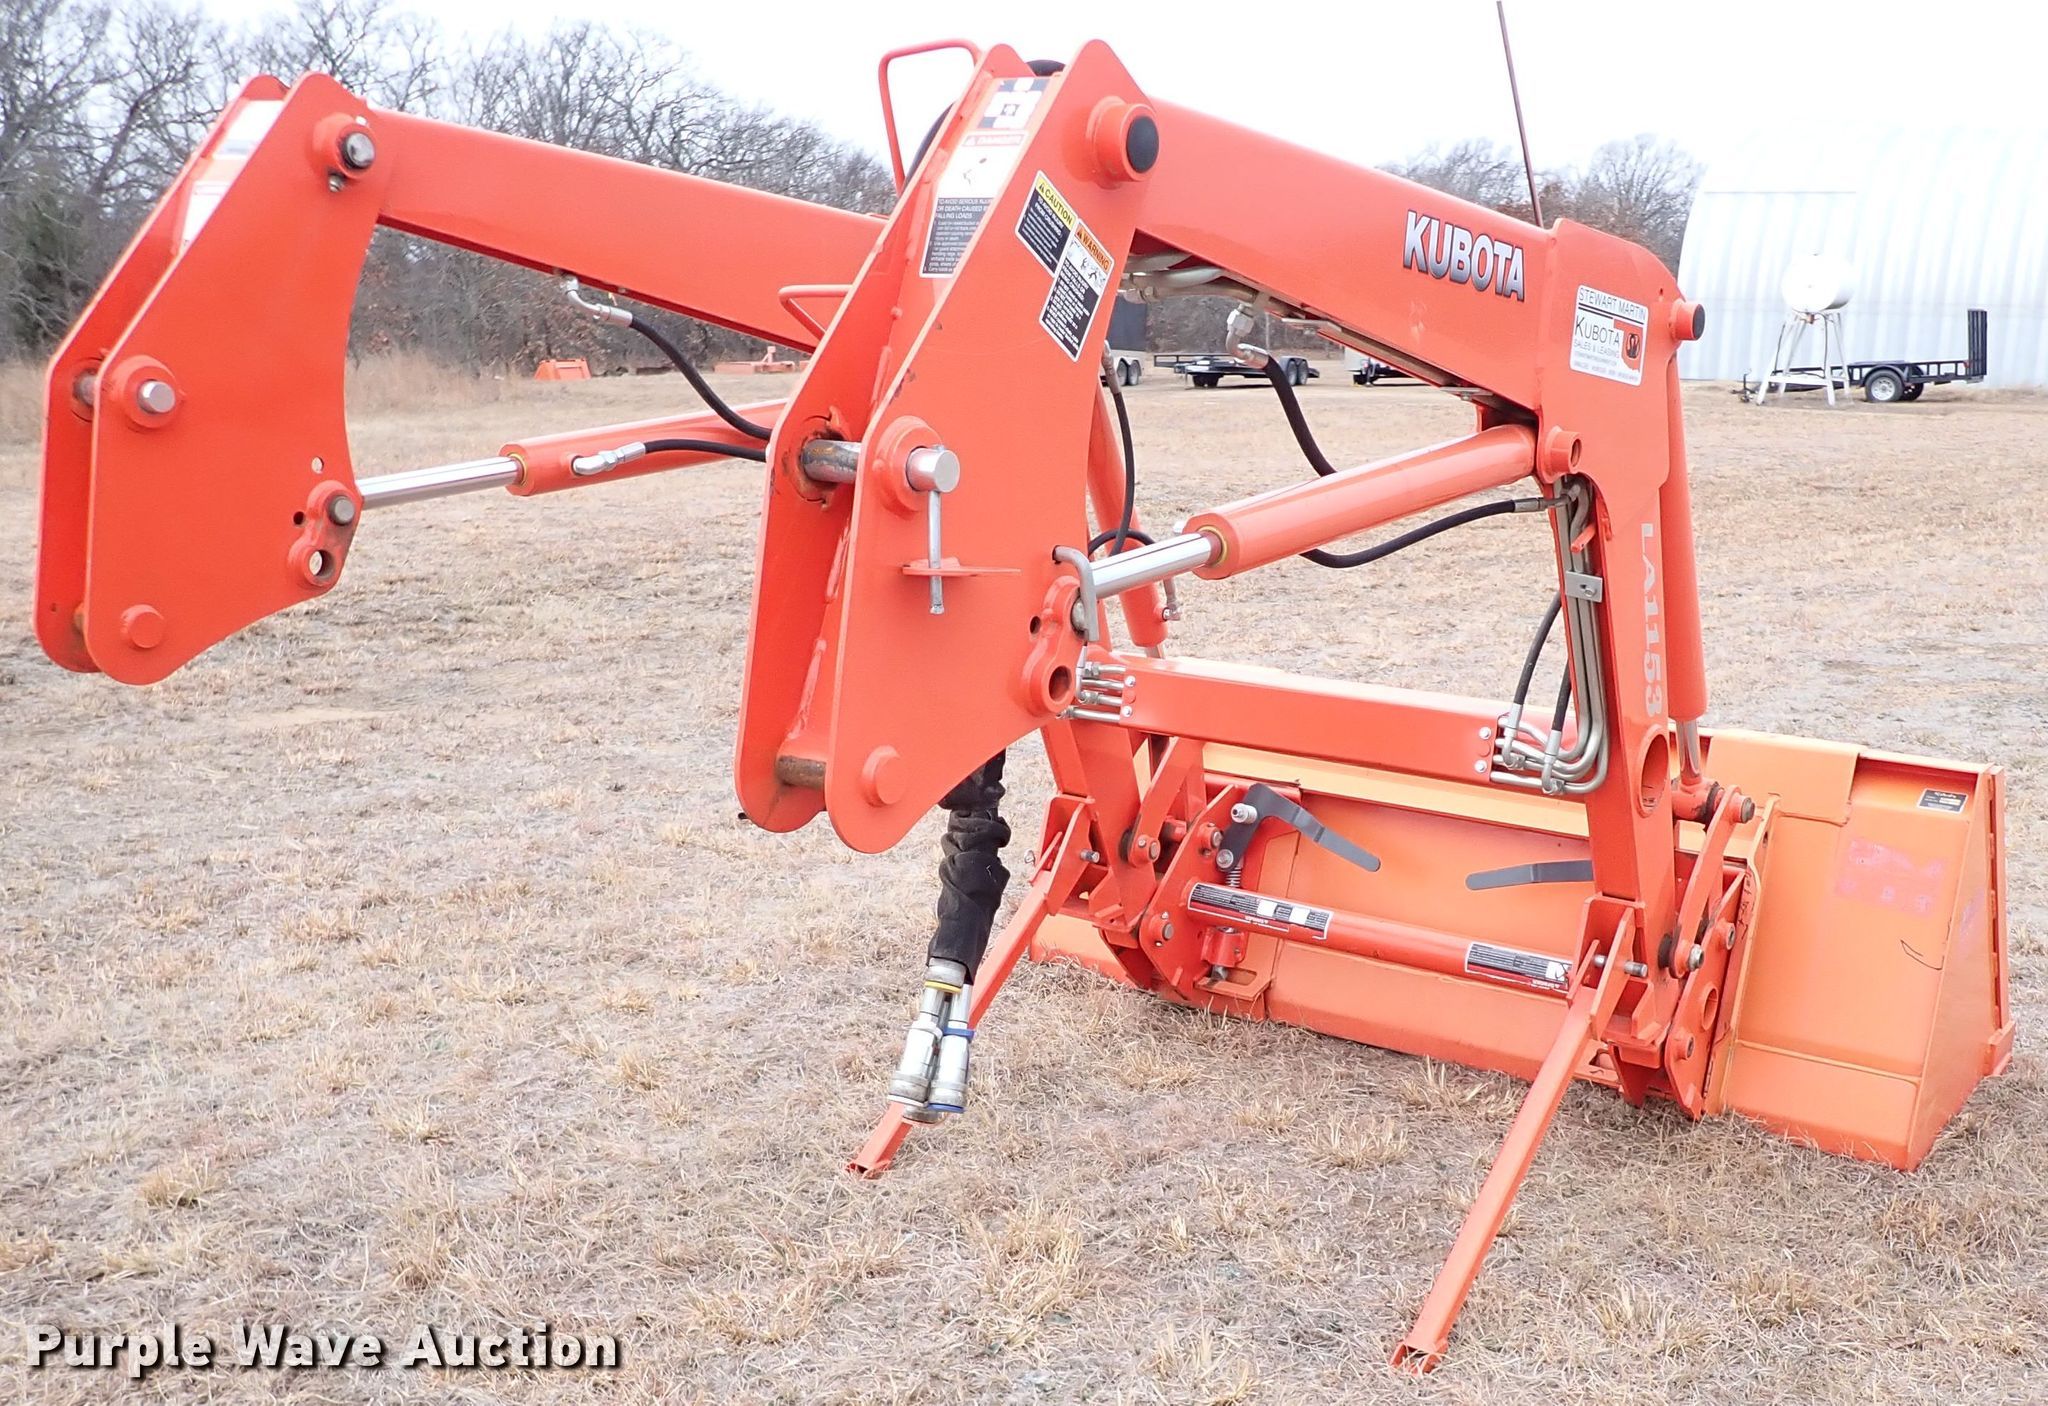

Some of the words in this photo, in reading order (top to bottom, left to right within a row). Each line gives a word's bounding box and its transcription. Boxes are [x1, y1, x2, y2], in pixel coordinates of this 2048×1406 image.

[1044, 188, 1073, 226] CAUTION
[1083, 234, 1109, 271] WARNING
[1403, 209, 1525, 303] KUBOTA
[1579, 287, 1617, 308] STEWART
[1618, 300, 1646, 321] MARTIN
[1575, 315, 1620, 347] KUBOTA
[1641, 523, 1663, 717] LA1153
